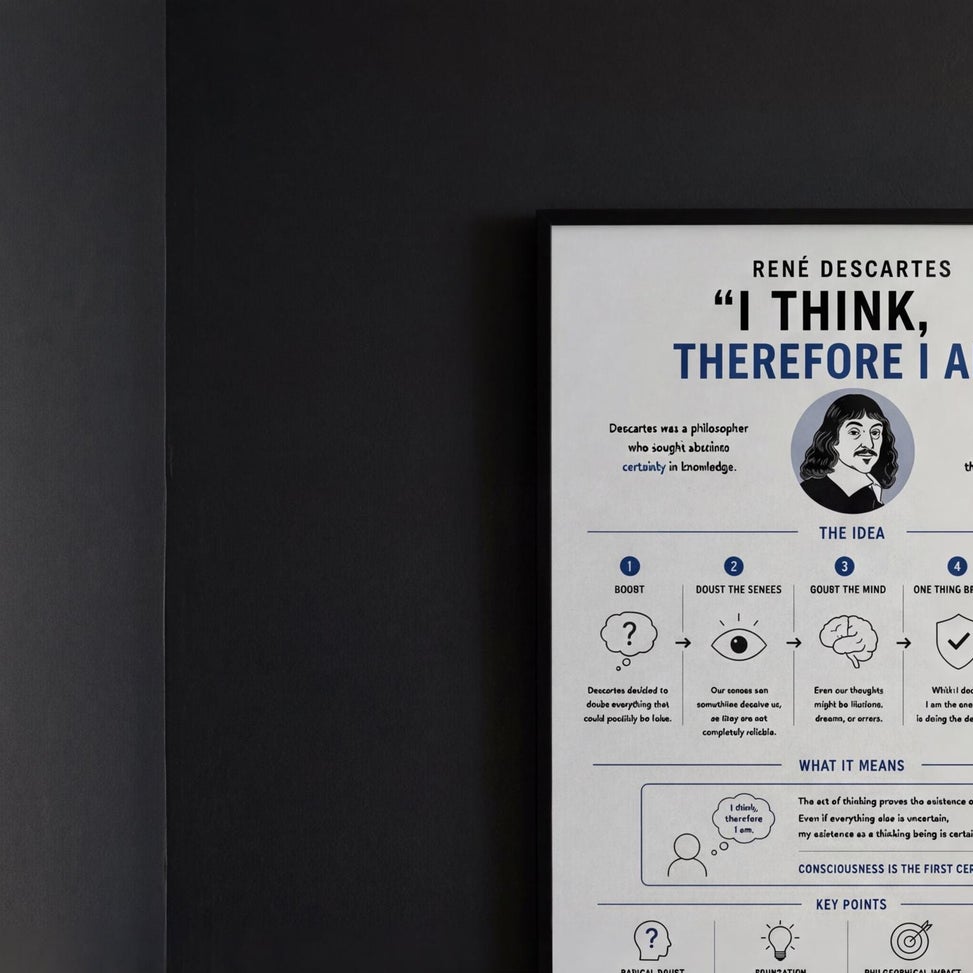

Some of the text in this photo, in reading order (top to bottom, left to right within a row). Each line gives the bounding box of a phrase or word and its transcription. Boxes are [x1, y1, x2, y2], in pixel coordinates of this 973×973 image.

[752, 254, 951, 278] RENÉ DESCARTES
[770, 290, 928, 338] THINK,
[672, 342, 903, 380] THEREFORE
[919, 342, 928, 380] I
[681, 425, 688, 434] a
[690, 422, 749, 438] philosopher
[627, 440, 650, 453] who
[668, 460, 678, 472] in
[818, 526, 886, 540] THE IDEA
[695, 584, 782, 595] DOUST THE SENEES
[842, 584, 860, 594] THE
[862, 584, 887, 594] MIND
[913, 584, 932, 595] ONE
[933, 584, 962, 594] THING
[710, 686, 726, 695] Our
[798, 759, 905, 772] WHAT IT MEANS
[831, 795, 842, 806] of
[821, 813, 829, 823] if
[797, 831, 812, 841] my
[912, 828, 938, 841] being
[939, 828, 948, 839] is
[798, 863, 885, 874] CONSCIOUSNESS
[887, 863, 898, 874] IS
[900, 863, 921, 874] THE
[923, 863, 954, 874] FIRST
[816, 898, 887, 911] KEY POINTS
